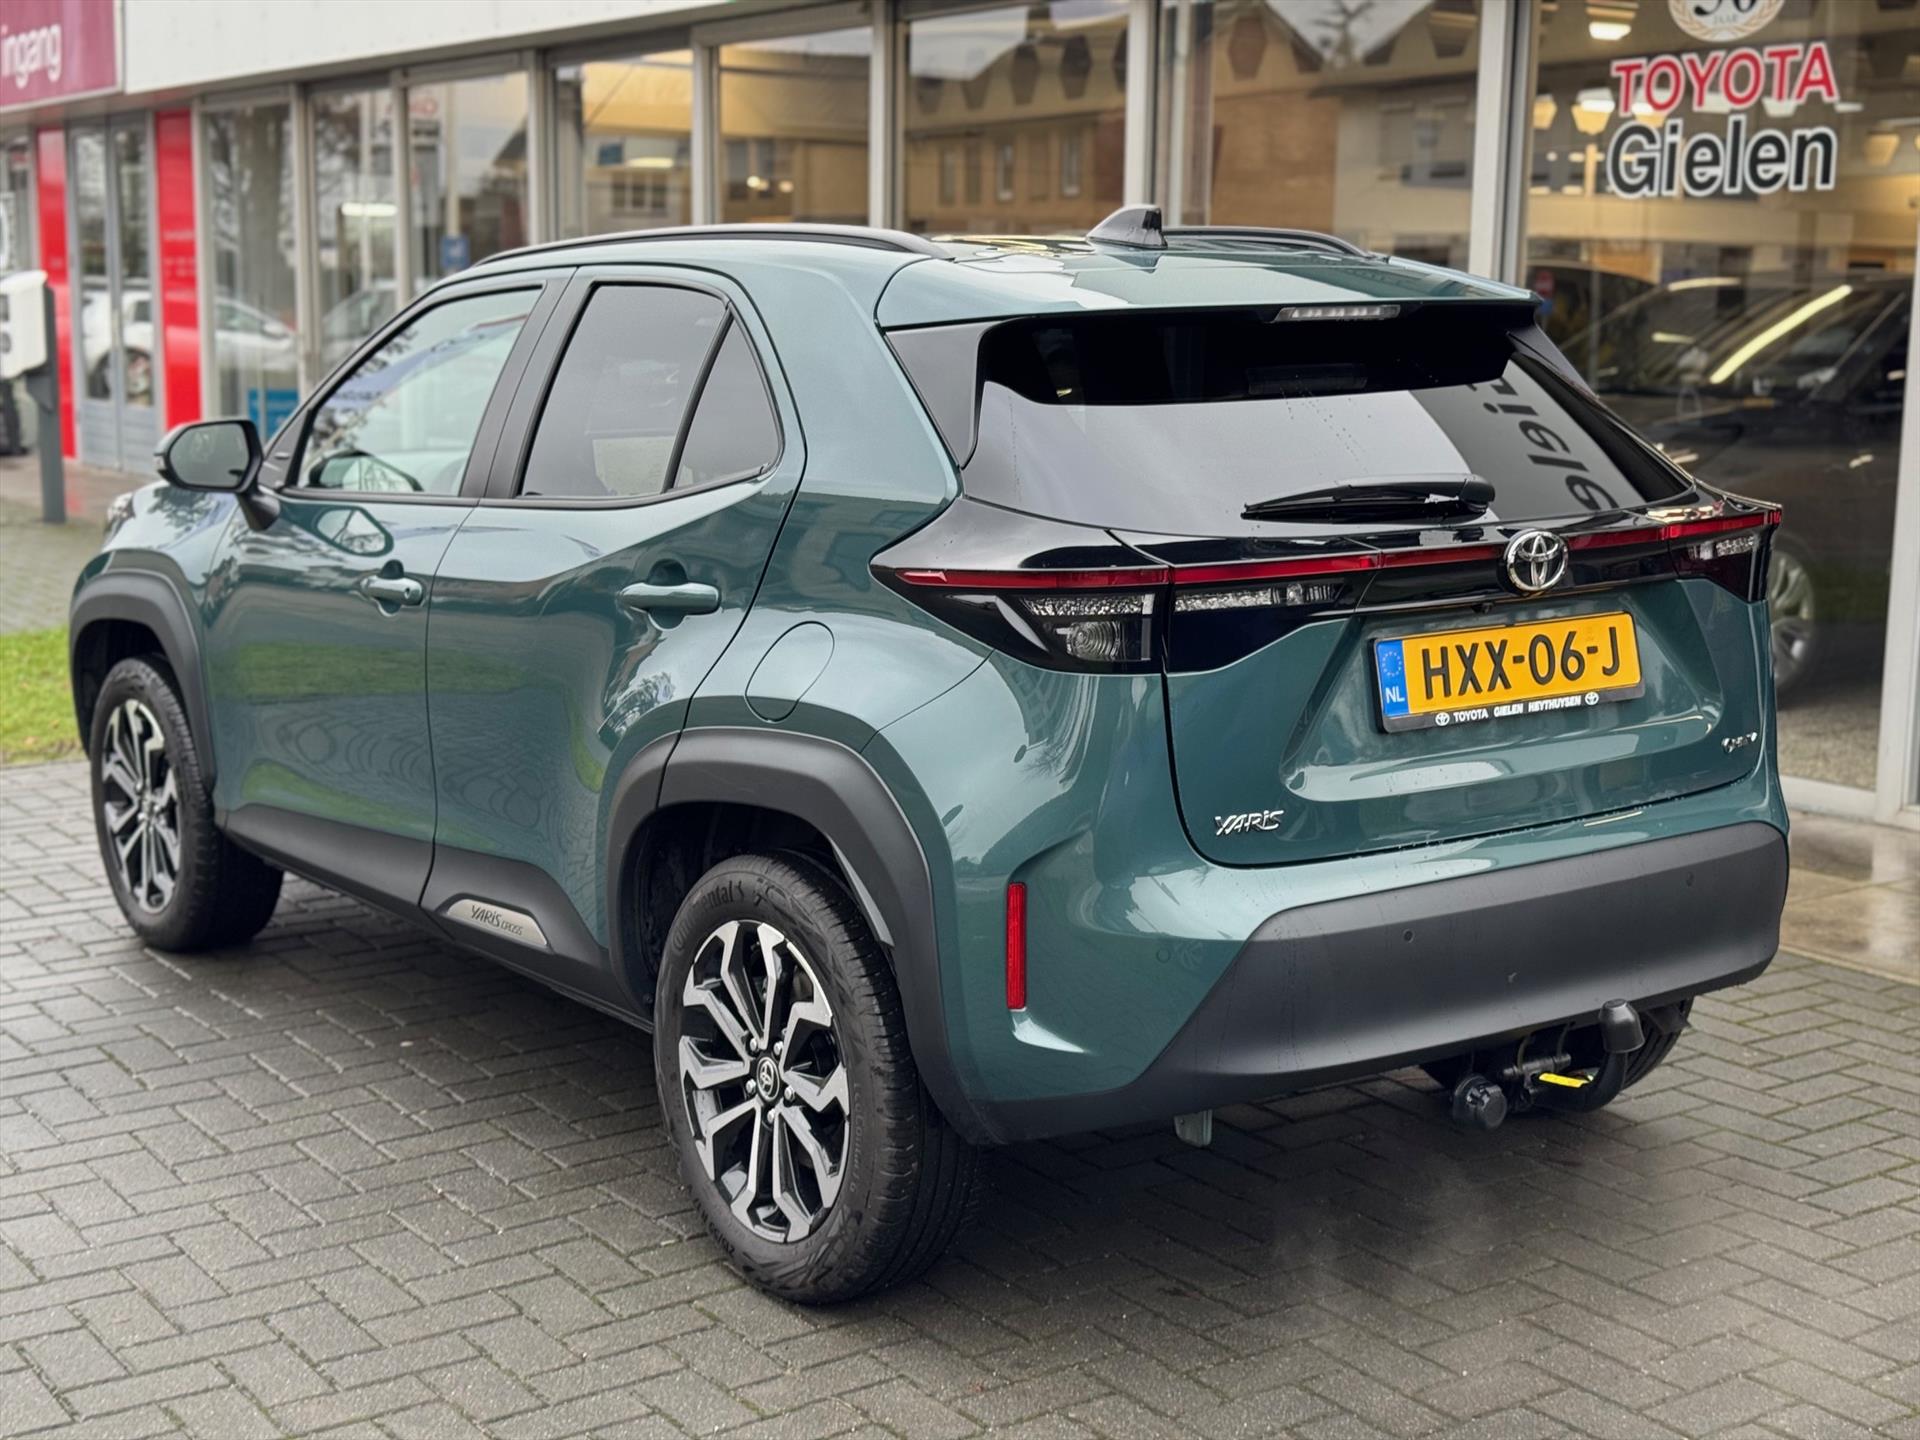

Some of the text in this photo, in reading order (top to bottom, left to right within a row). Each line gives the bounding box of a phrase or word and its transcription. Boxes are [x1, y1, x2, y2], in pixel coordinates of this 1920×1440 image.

[0, 24, 61, 88] ingang
[1612, 43, 1837, 116] TOYOTA
[1608, 114, 1837, 198] Gielen
[1385, 686, 1405, 704] NL
[1421, 627, 1621, 700] HXX-06-J
[1453, 695, 1581, 722] TOYOTA GIELEN HEYTHUYSEN
